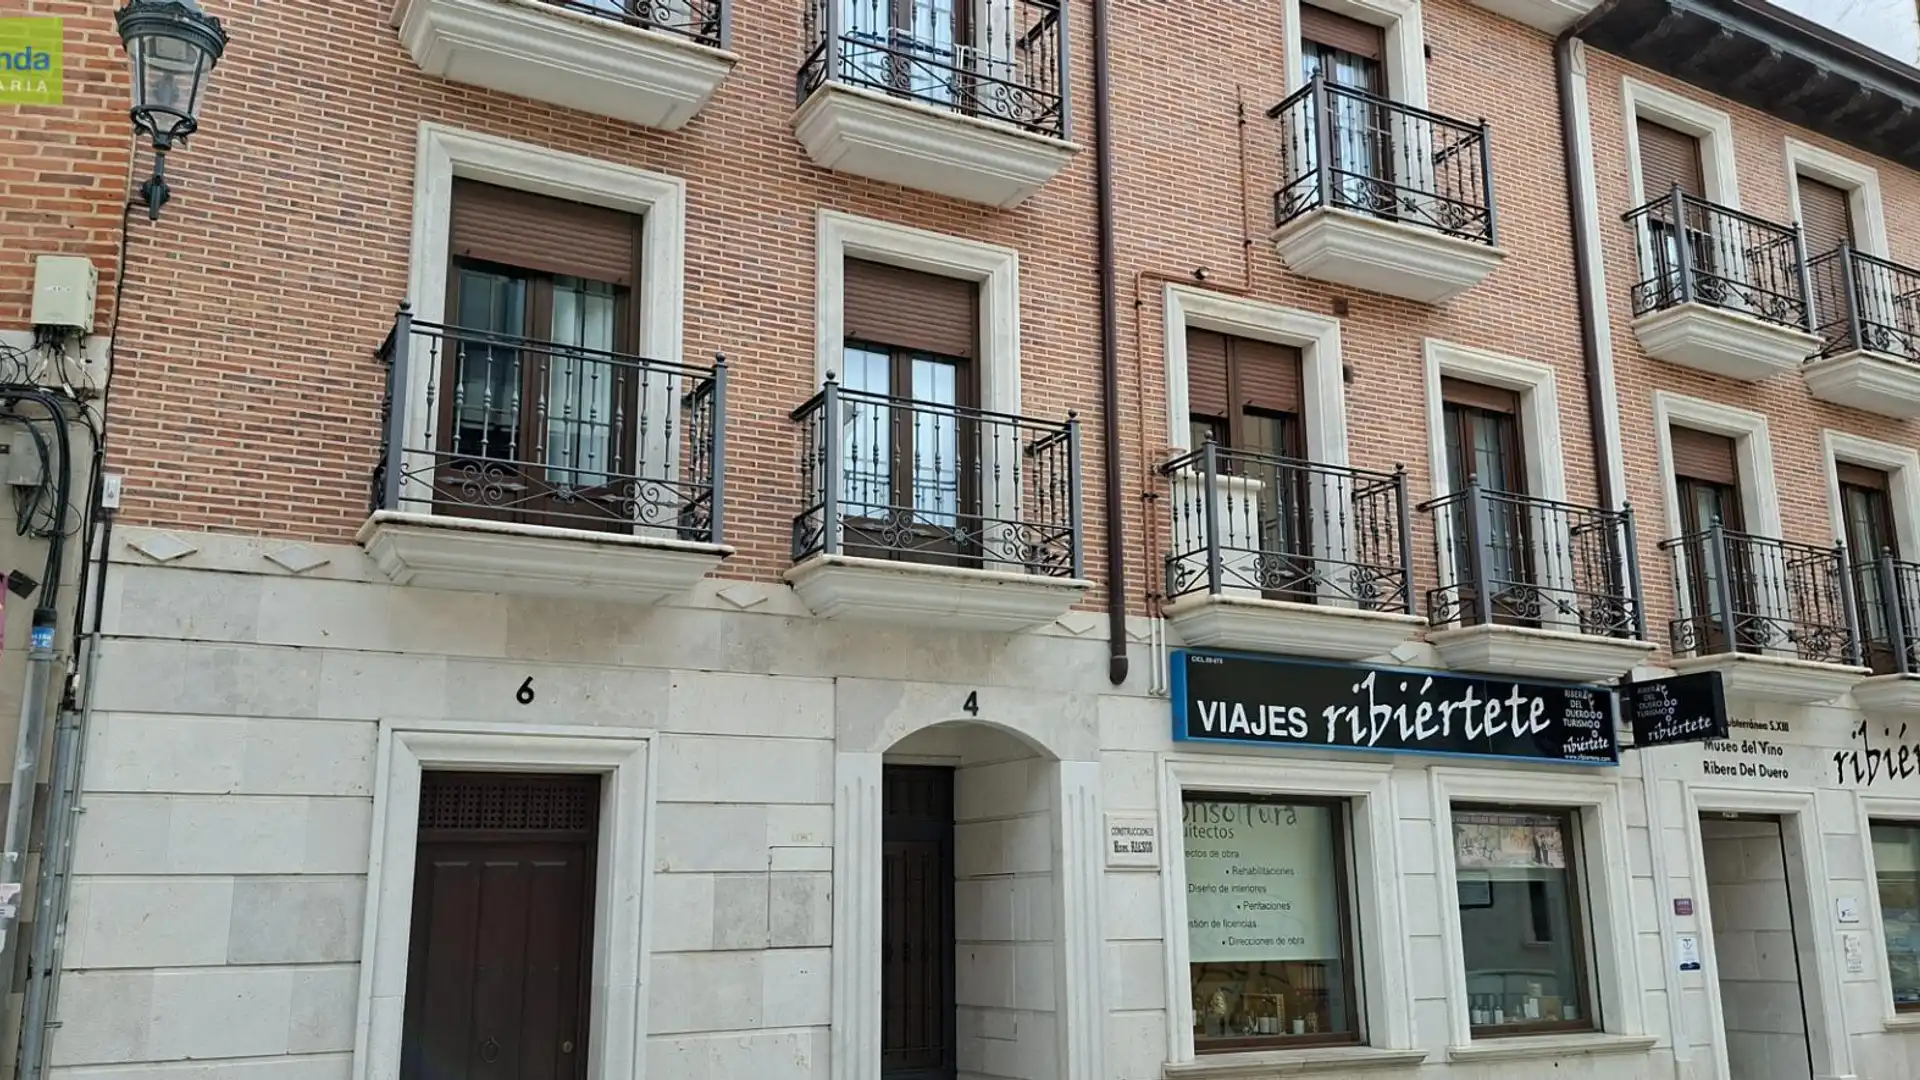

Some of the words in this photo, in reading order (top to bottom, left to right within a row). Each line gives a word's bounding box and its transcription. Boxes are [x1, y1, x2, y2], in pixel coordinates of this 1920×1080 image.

[516, 675, 534, 705] 6
[963, 690, 979, 717] 4
[1197, 700, 1308, 738] VIAJES
[1322, 671, 1550, 747] ribiértete
[1570, 700, 1583, 709] DEL
[1648, 716, 1713, 741] ribiértete
[1704, 741, 1738, 753] Museo
[1741, 740, 1757, 754] del
[1758, 741, 1783, 756] Vino
[1703, 760, 1737, 776] Ribera
[1739, 762, 1756, 777] Del
[1759, 763, 1789, 779] Duero
[1209, 850, 1219, 858] de
[1221, 850, 1240, 859] obra
[1219, 884, 1229, 893] de
[1210, 919, 1221, 929] de
